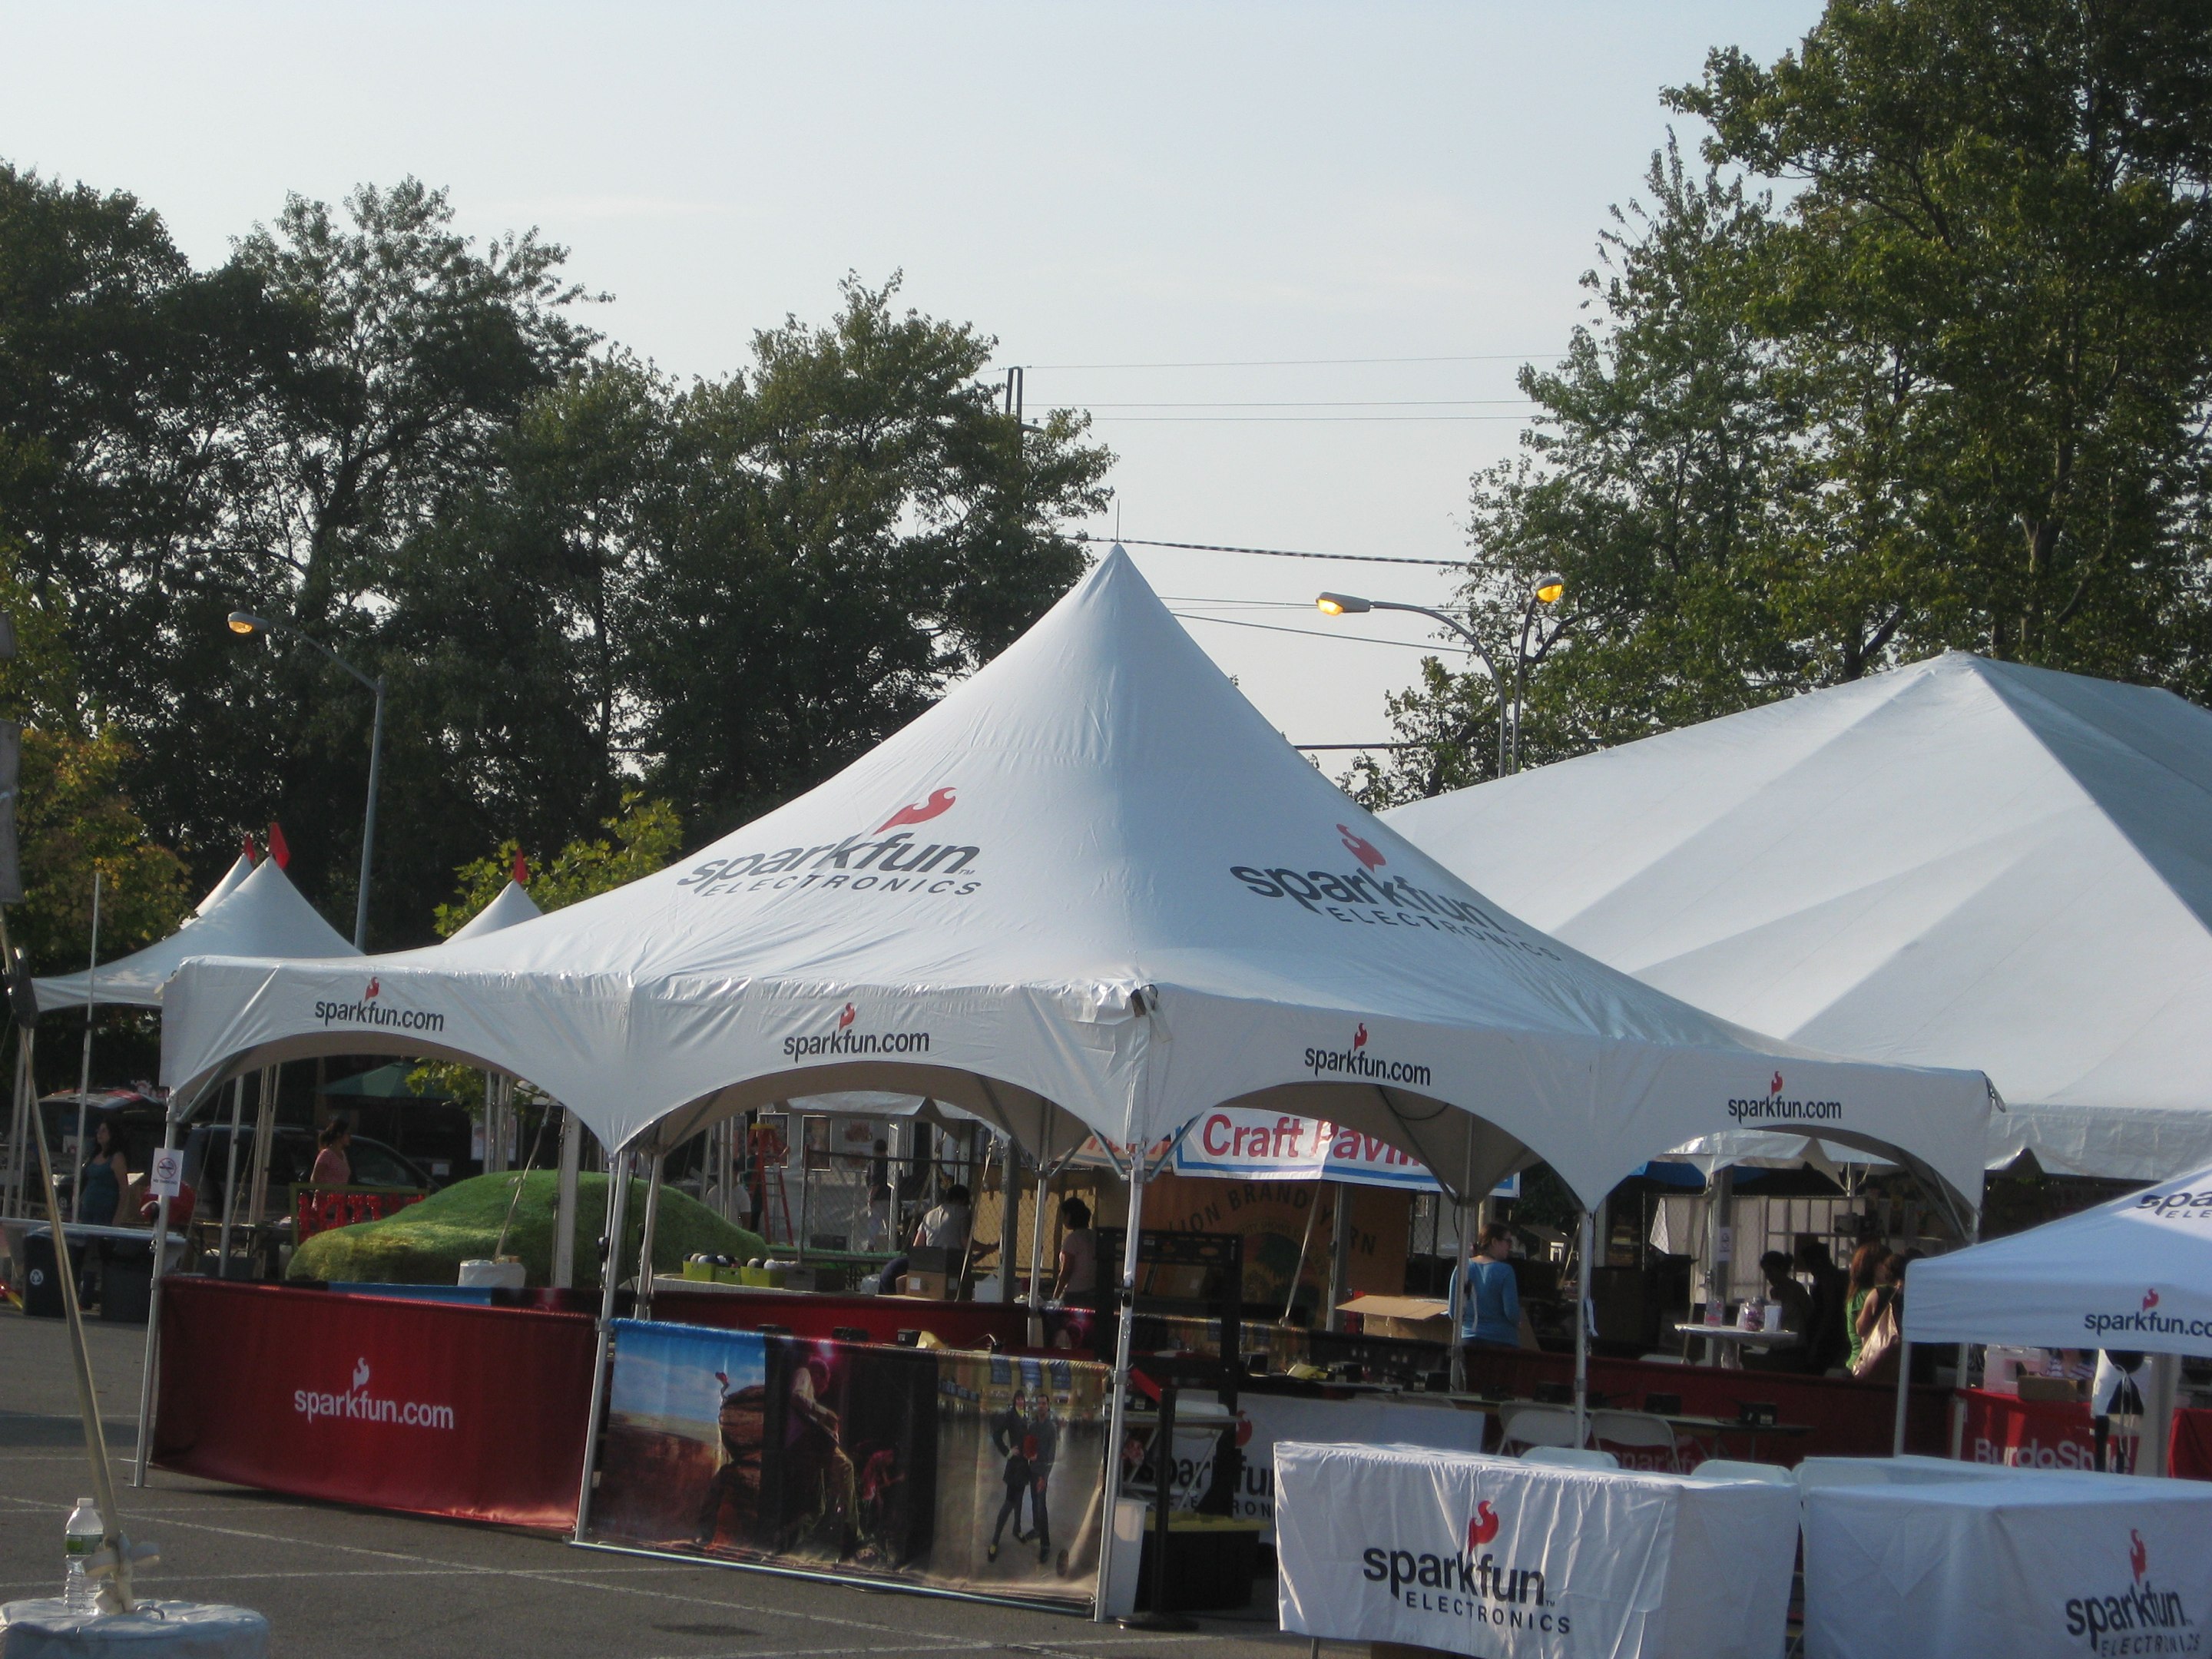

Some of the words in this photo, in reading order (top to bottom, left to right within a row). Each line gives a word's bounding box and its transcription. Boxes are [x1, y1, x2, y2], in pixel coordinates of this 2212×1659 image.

[677, 832, 980, 894] sparkfun
[702, 874, 982, 897] ELECTRONICS
[1230, 866, 1508, 933] sparkfun
[1325, 906, 1562, 962] ELECTRONICS
[315, 1000, 445, 1032] sparkfun.com
[783, 1029, 930, 1065] sparkfun.com
[1304, 1048, 1431, 1087] sparkfun.com
[1728, 1094, 1843, 1124] sparkfun.com
[1203, 1114, 1304, 1158] Craft
[1228, 1182, 1307, 1211] BRAND
[294, 1389, 454, 1429] sparkfun.com
[1363, 1548, 1545, 1606] sparkfun
[1406, 1591, 1571, 1634] ELECTRONICS
[2065, 1579, 2187, 1652] sparkfun
